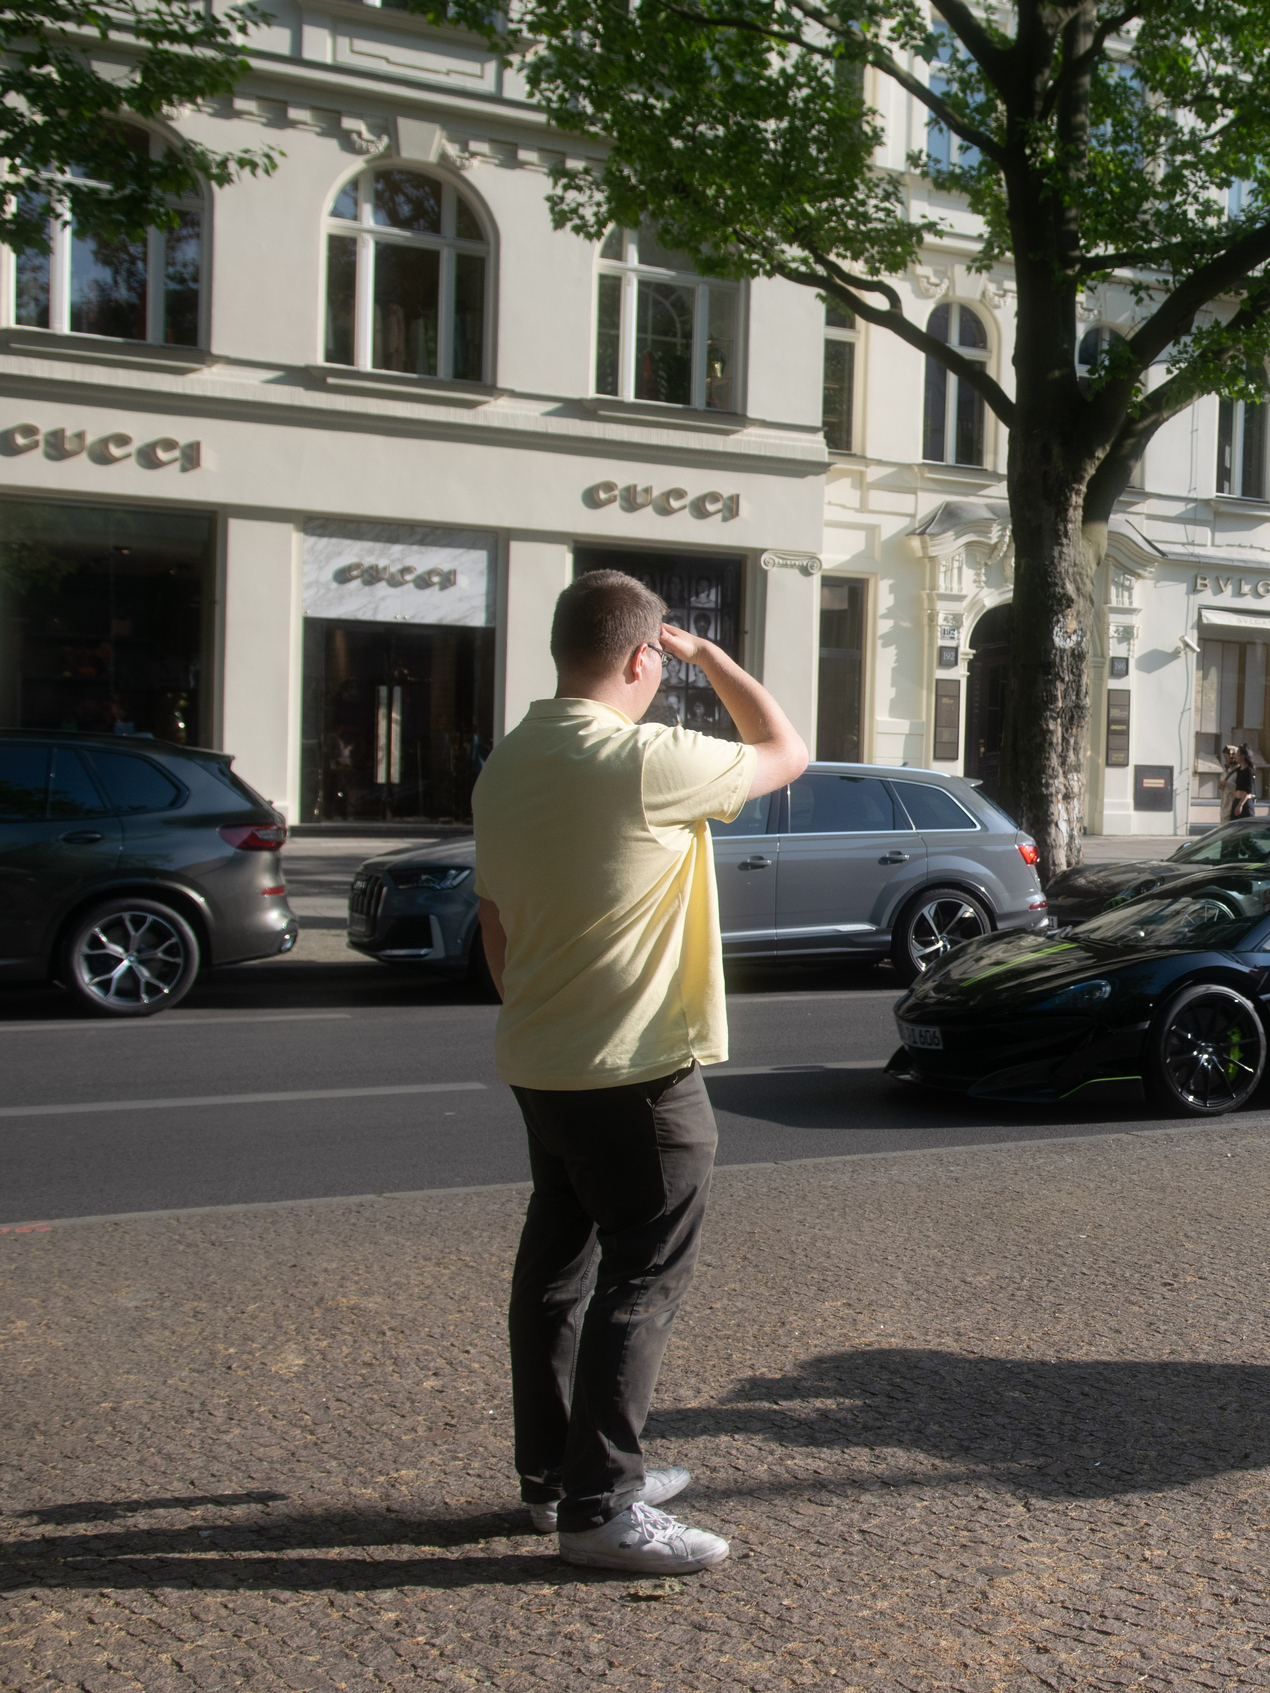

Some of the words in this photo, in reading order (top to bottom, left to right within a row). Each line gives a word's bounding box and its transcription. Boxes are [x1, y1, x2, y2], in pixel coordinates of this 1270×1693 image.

[1, 422, 202, 472] GUCCI
[582, 480, 740, 522] GUCCI
[333, 561, 457, 591] GUCCI
[942, 628, 955, 636] 192
[943, 652, 955, 660] 192
